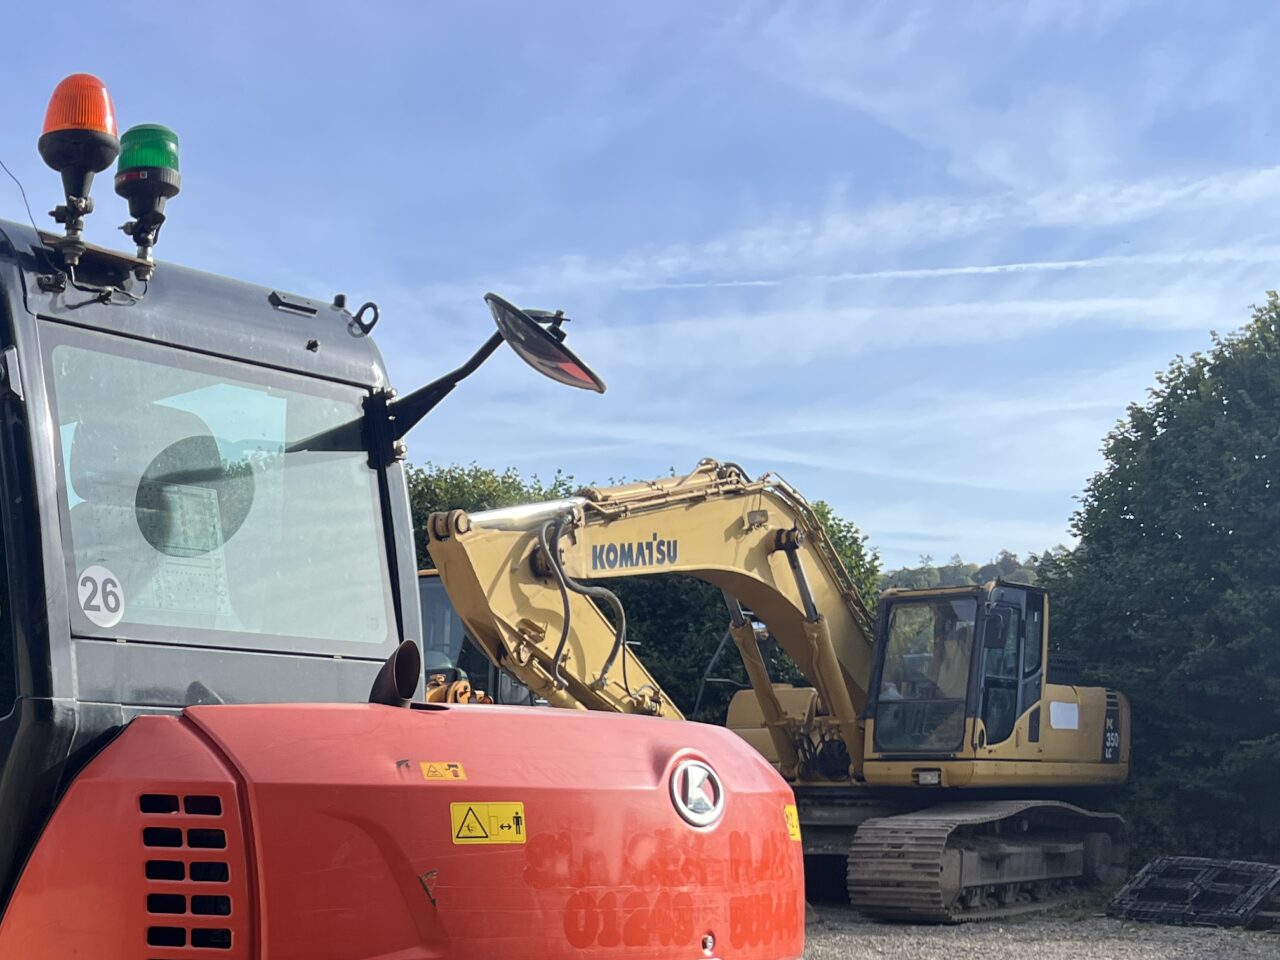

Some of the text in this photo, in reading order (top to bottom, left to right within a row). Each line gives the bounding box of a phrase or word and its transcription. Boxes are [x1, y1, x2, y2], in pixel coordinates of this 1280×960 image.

[592, 532, 678, 570] KOMATSU
[80, 576, 121, 613] 26
[1106, 732, 1119, 747] 350
[1105, 748, 1112, 758] LC
